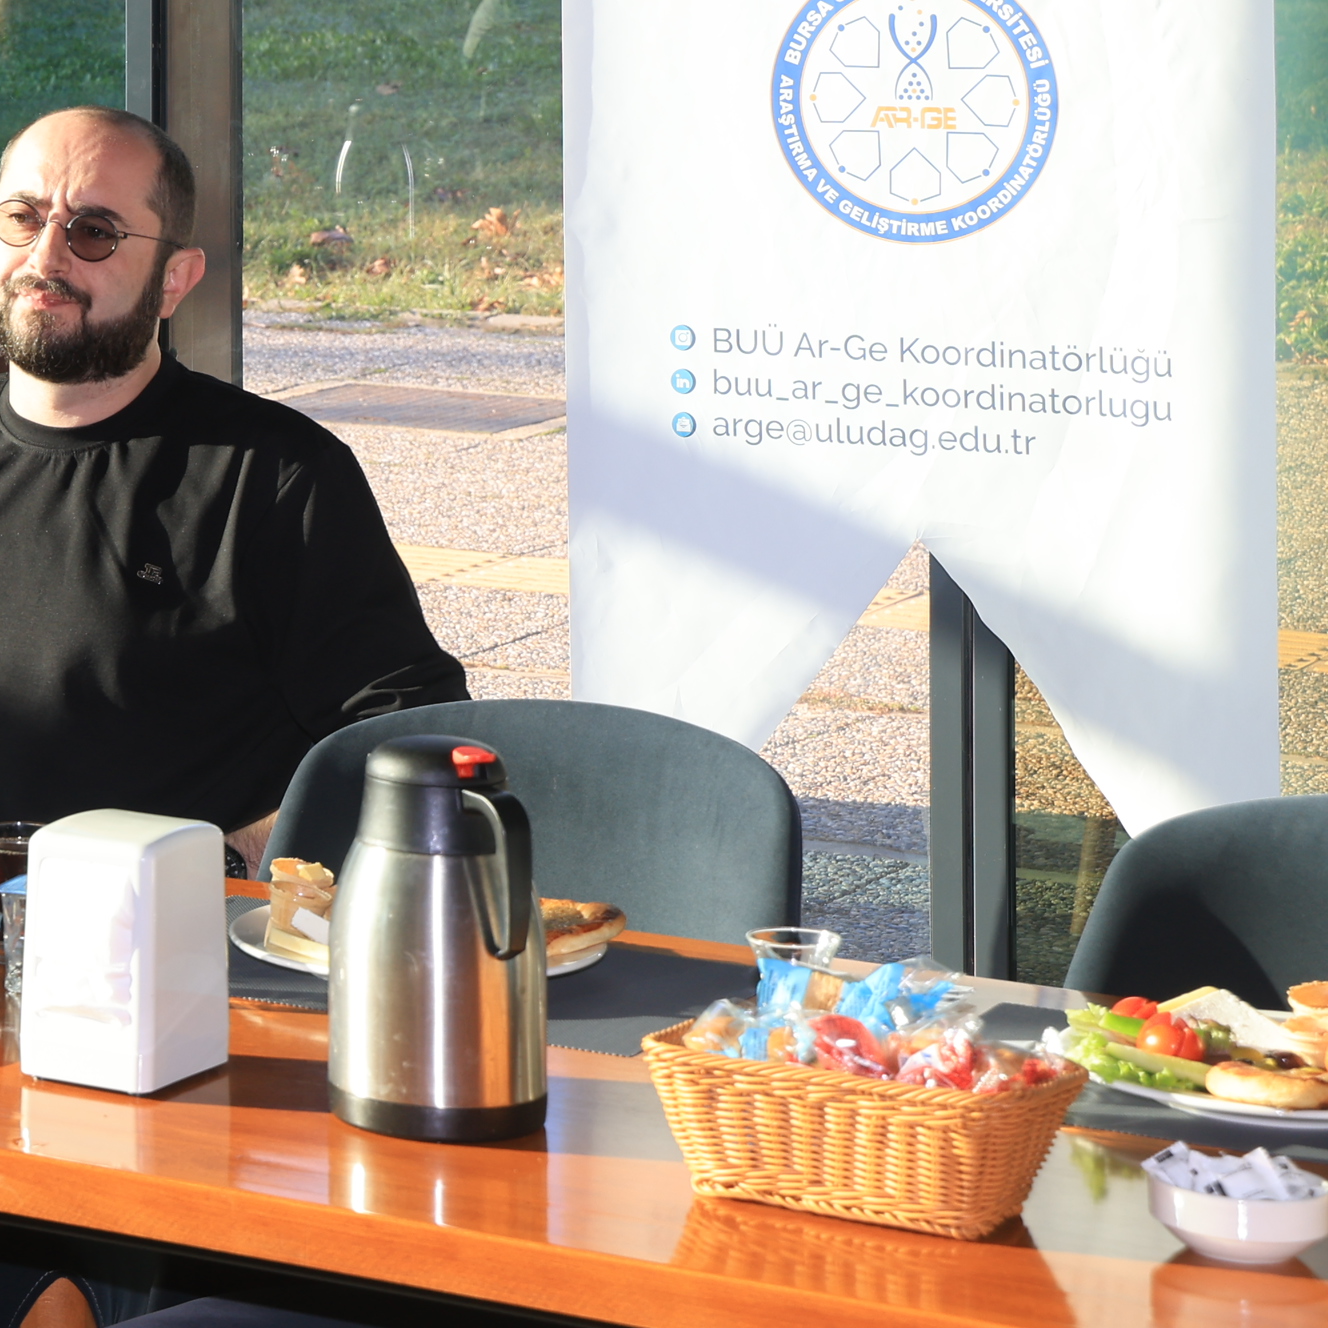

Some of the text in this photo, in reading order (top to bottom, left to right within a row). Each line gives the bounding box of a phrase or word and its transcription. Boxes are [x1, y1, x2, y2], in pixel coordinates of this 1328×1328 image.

[784, 3, 834, 66] BURSA
[870, 106, 957, 130] AR-GE
[777, 74, 1052, 237] ARAŞTIRMA VE GELİŞTİRME KOORDİNATÖRLÜĞÜ
[712, 323, 1173, 384] BUÜ Ar-Ge Koordinatörlüğü
[712, 368, 1173, 428] buu_ar_ge_koordinatorlugu
[712, 414, 1036, 457] arge@uludag.edu.tr
